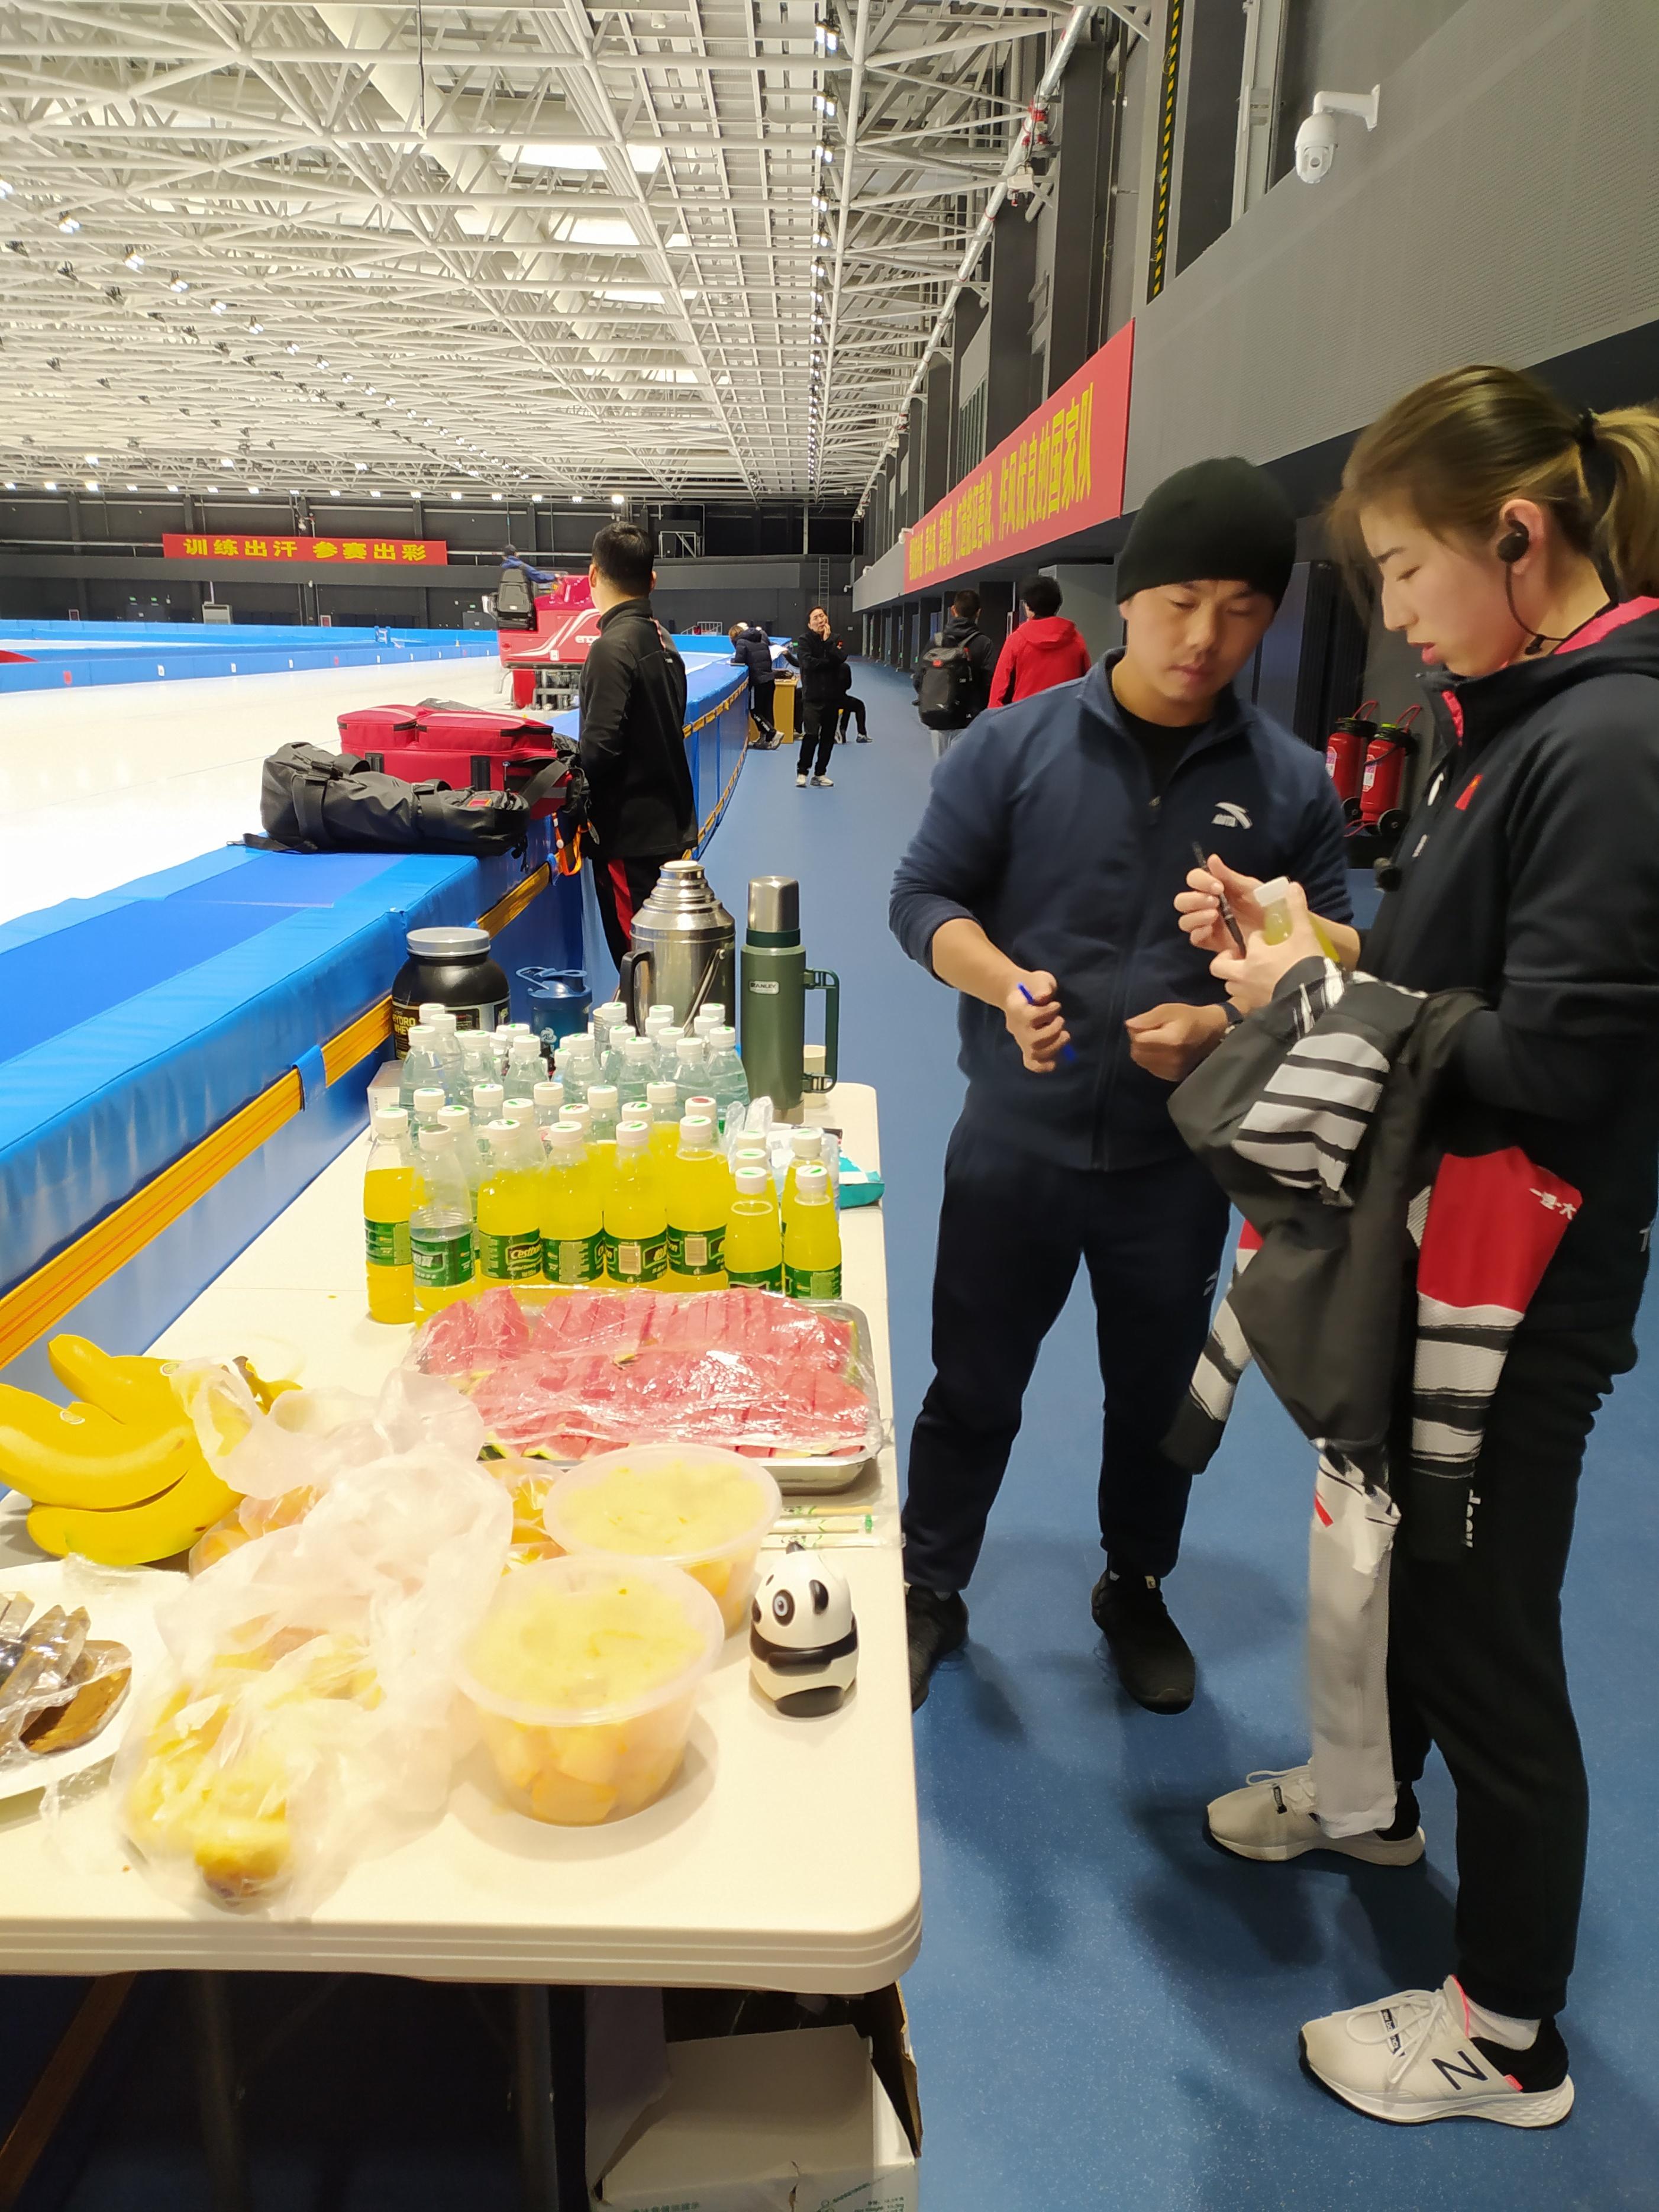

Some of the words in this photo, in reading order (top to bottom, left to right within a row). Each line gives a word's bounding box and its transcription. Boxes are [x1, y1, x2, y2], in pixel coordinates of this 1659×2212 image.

[183, 538, 298, 557] 训练出汗
[312, 541, 427, 562] 参赛出彩
[392, 1014, 416, 1027] HYDRO
[1431, 2050, 1490, 2091] N
